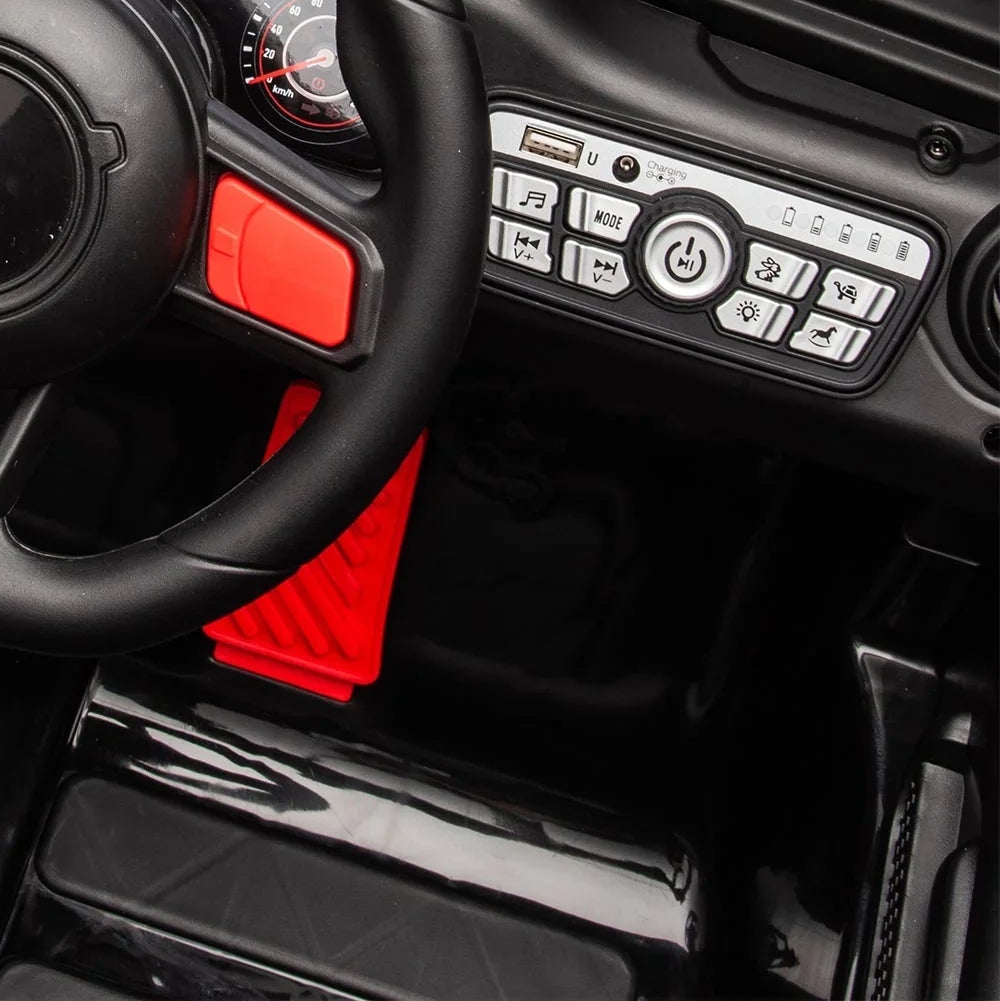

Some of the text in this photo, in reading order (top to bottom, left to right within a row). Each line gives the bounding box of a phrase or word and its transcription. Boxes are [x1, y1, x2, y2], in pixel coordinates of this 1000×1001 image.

[289, 4, 301, 17] 60
[270, 23, 283, 36] 40
[263, 48, 275, 60] 20
[272, 84, 294, 99] km/h
[587, 151, 599, 166] U
[647, 160, 688, 181] Charging
[594, 210, 624, 231] MODE
[513, 248, 535, 260] V+
